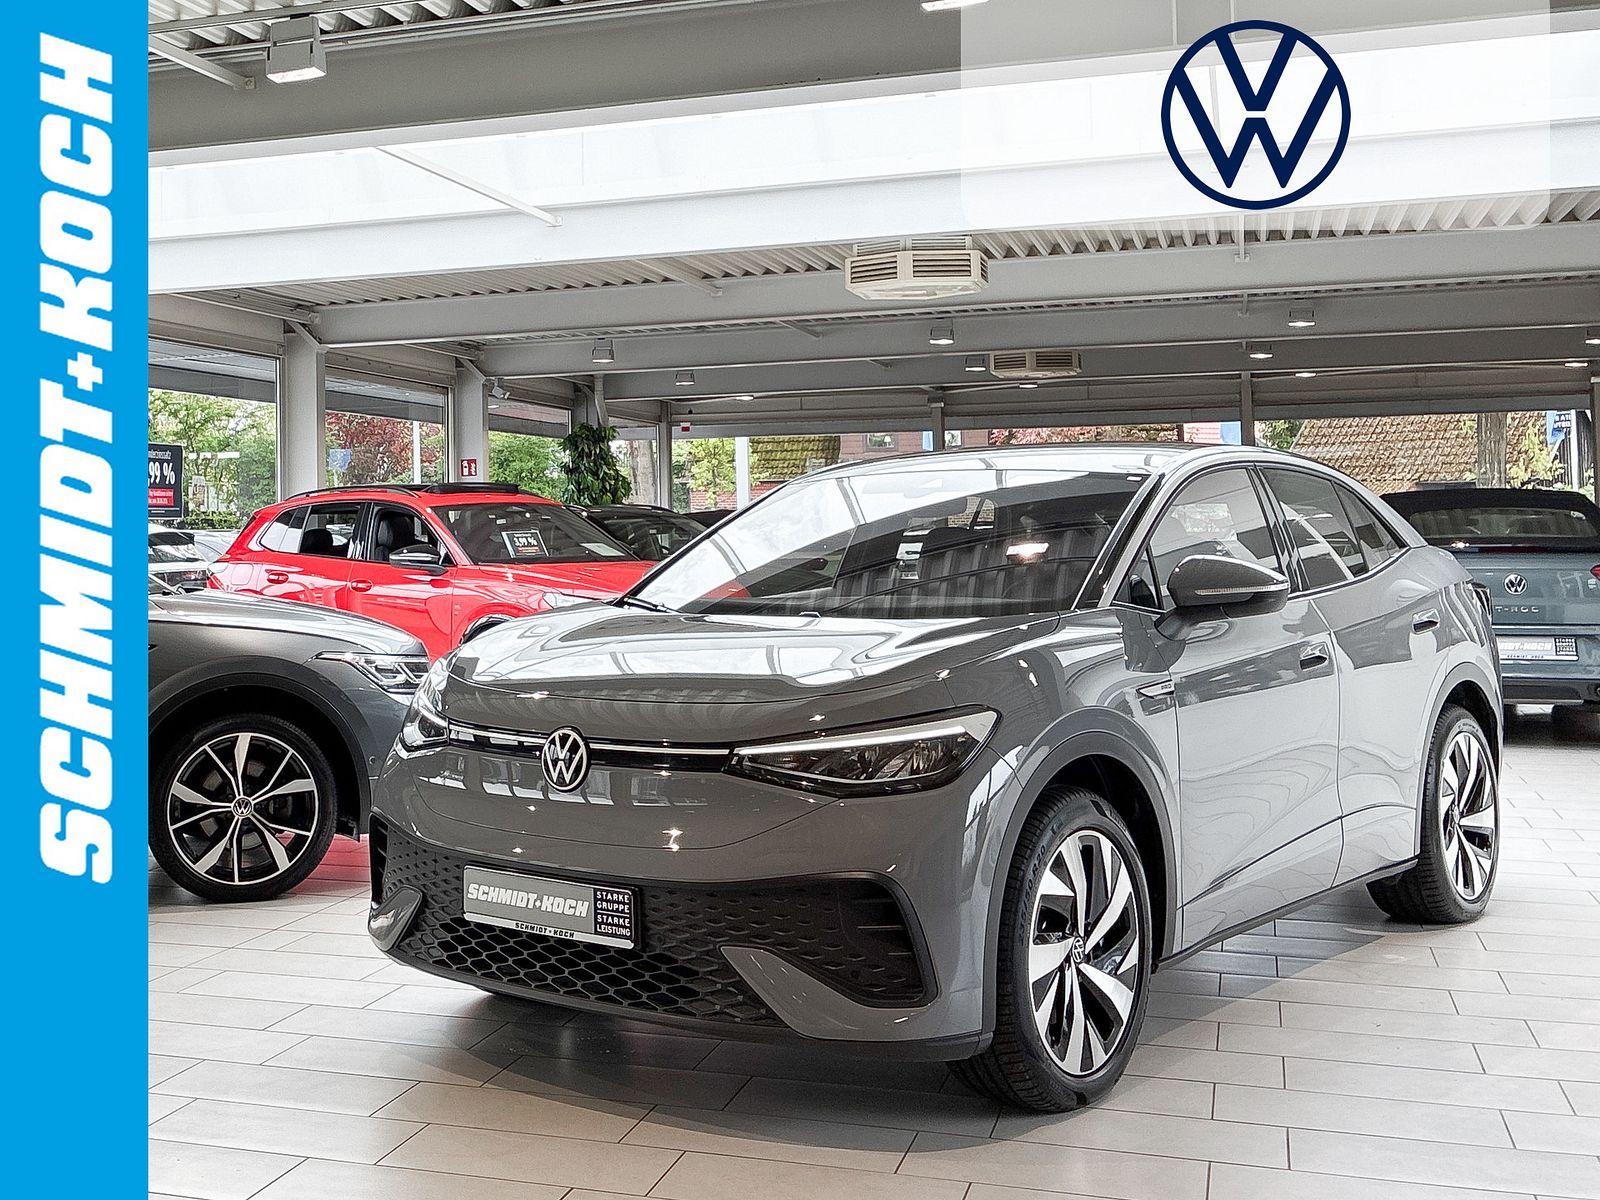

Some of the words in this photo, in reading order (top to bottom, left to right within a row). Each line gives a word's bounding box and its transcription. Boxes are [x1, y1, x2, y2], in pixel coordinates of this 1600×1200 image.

[467, 883, 590, 918] SCHMIDT+KOCH
[596, 891, 630, 903] STARKE
[596, 900, 630, 913] GRUPPE
[597, 914, 631, 927] STARKE
[596, 924, 631, 937] LEISTUNG
